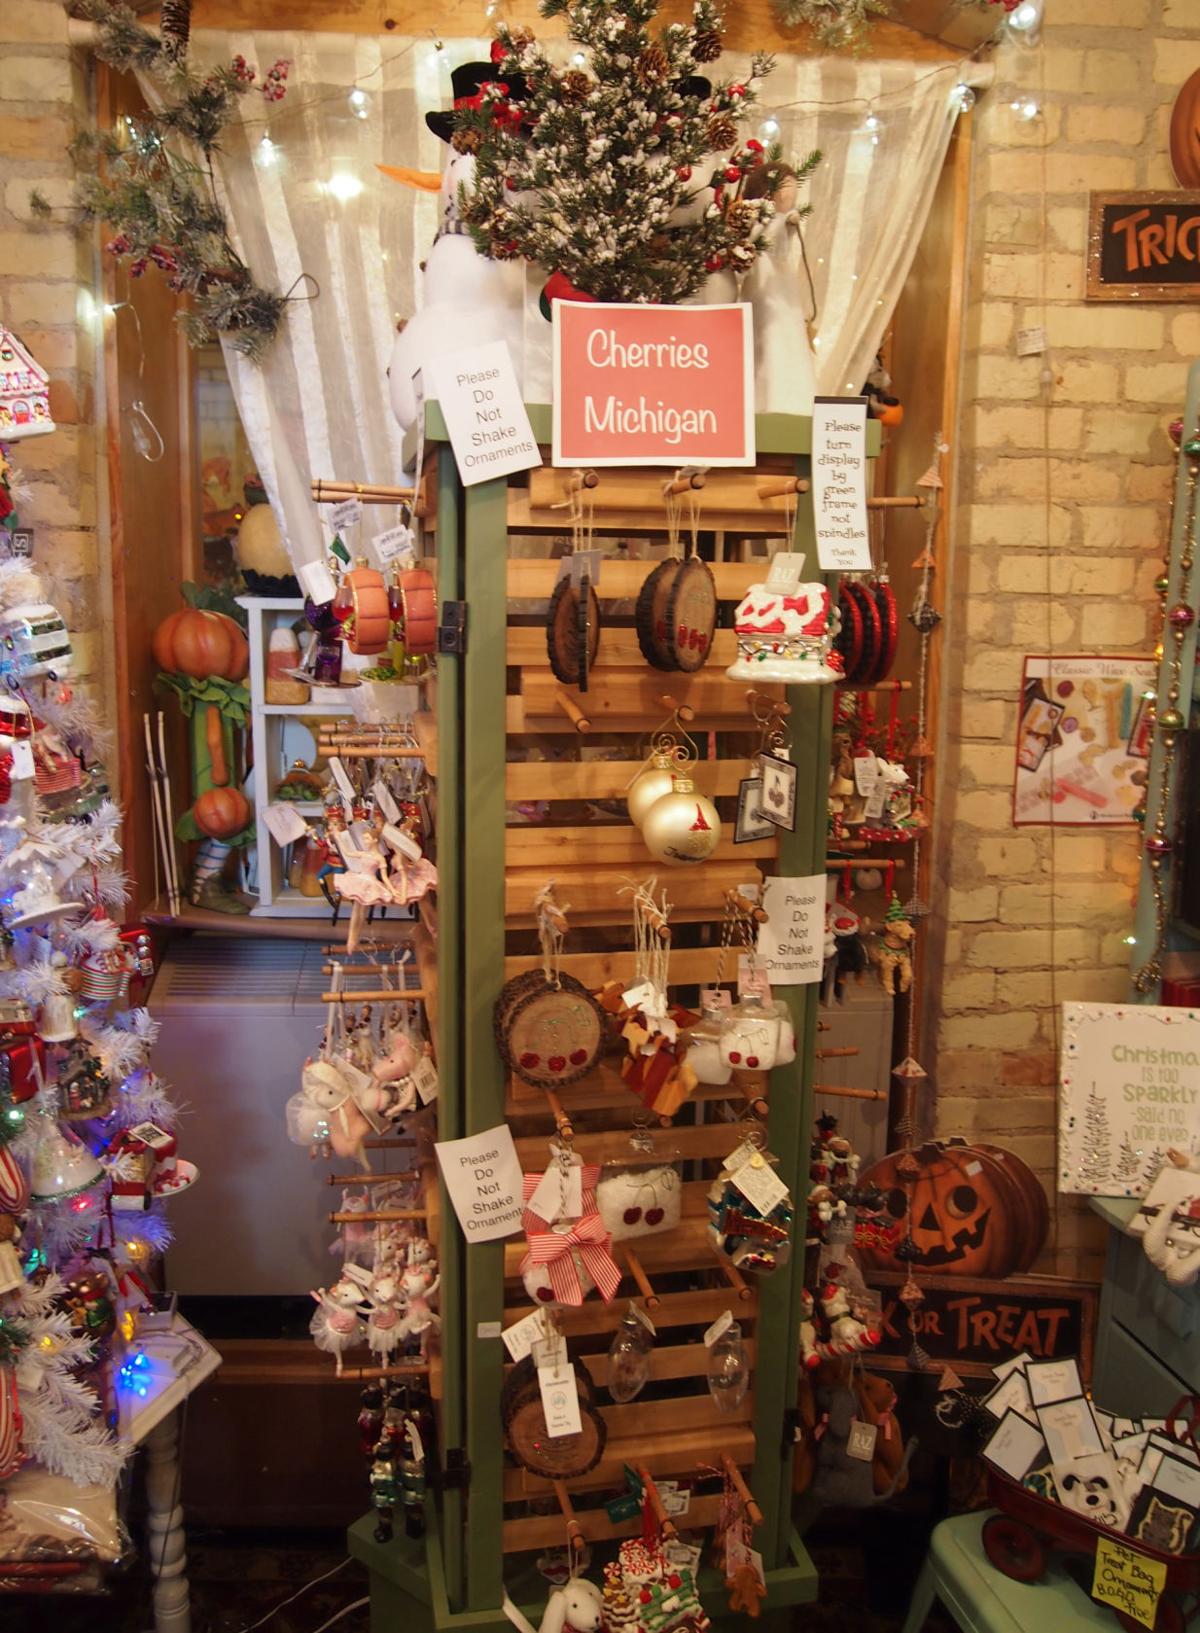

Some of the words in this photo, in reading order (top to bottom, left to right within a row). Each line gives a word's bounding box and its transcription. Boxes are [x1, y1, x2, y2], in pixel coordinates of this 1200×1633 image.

[1112, 208, 1200, 272] TRIC
[587, 328, 710, 369] Cherries
[456, 368, 500, 387] Please
[473, 389, 494, 404] Do
[475, 408, 502, 424] Not
[584, 395, 718, 444] Michigan
[825, 419, 862, 432] Please
[471, 426, 517, 447] Shake
[826, 439, 852, 450] turn
[464, 441, 534, 468] Ornaments
[817, 453, 861, 470] display
[831, 469, 848, 485] by
[823, 486, 856, 500] green
[821, 500, 858, 513] frame
[831, 513, 850, 523] not
[818, 527, 866, 539] spindles
[785, 895, 817, 906] Please
[793, 911, 808, 922] Do
[789, 928, 809, 939] Not
[778, 944, 813, 956] Shake
[1111, 1044, 1200, 1066] Christma
[460, 1149, 500, 1168] Please
[474, 1168, 494, 1181] Do
[477, 1182, 501, 1196] Not
[473, 1195, 513, 1215] Shake
[467, 1207, 523, 1231] Ornament
[907, 1311, 945, 1336] OR
